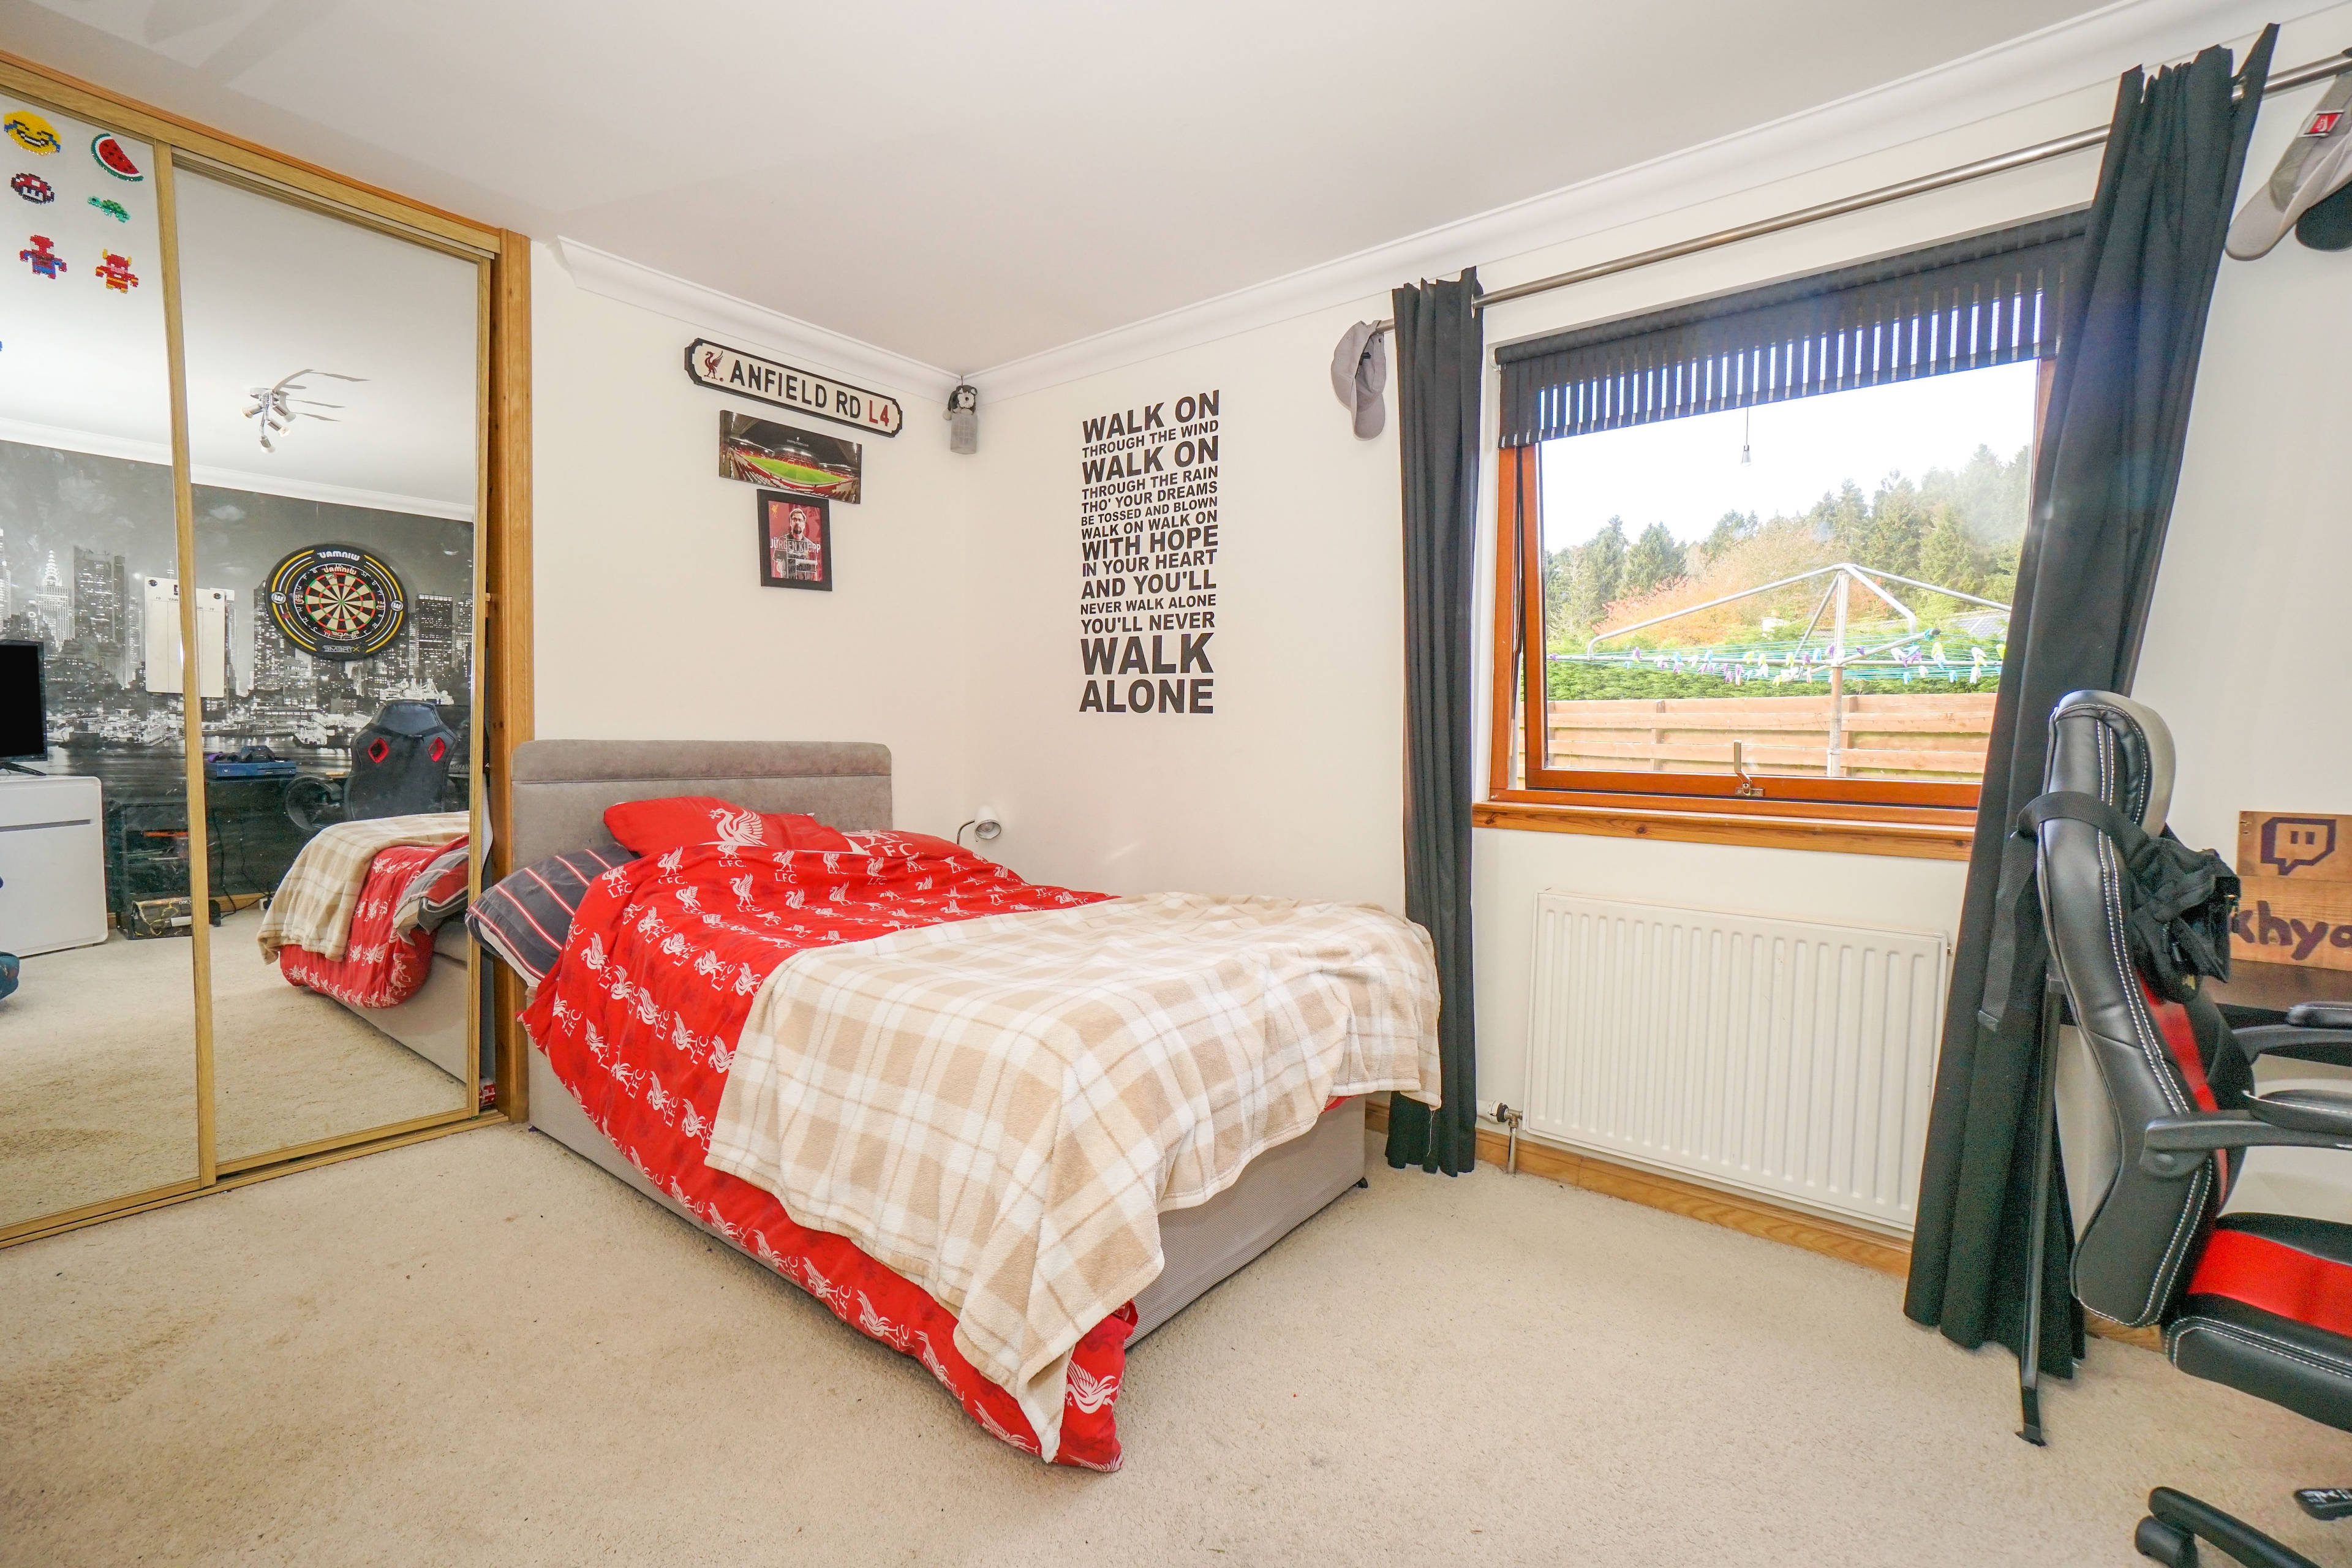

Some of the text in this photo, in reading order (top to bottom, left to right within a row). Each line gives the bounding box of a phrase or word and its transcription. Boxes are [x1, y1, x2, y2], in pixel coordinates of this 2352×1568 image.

[729, 360, 889, 427] ANFIELD RD L4
[1082, 390, 1219, 443] WALK ON
[1082, 420, 1218, 458] THROUGH THE WIND
[1082, 435, 1218, 484] WALK ON
[1082, 466, 1218, 500] THROUGH THE RAIN
[1082, 481, 1218, 513] THO' YOUR DREAMS
[1081, 496, 1218, 526] BE TOSSED AND BLOWN
[1082, 510, 1218, 540] WALK ON WALK ON
[1082, 524, 1218, 561] WITH HOPE
[1082, 549, 1217, 577] IN YOUR HEART
[1081, 569, 1216, 600] AND YOU'LL
[1080, 594, 1216, 615] NEVER WALK ALONE
[1081, 611, 1215, 634] YOU'LL NEVER
[1080, 632, 1214, 675] WALK
[1079, 679, 1213, 714] ALONE
[718, 859, 747, 868] L.F.C.
